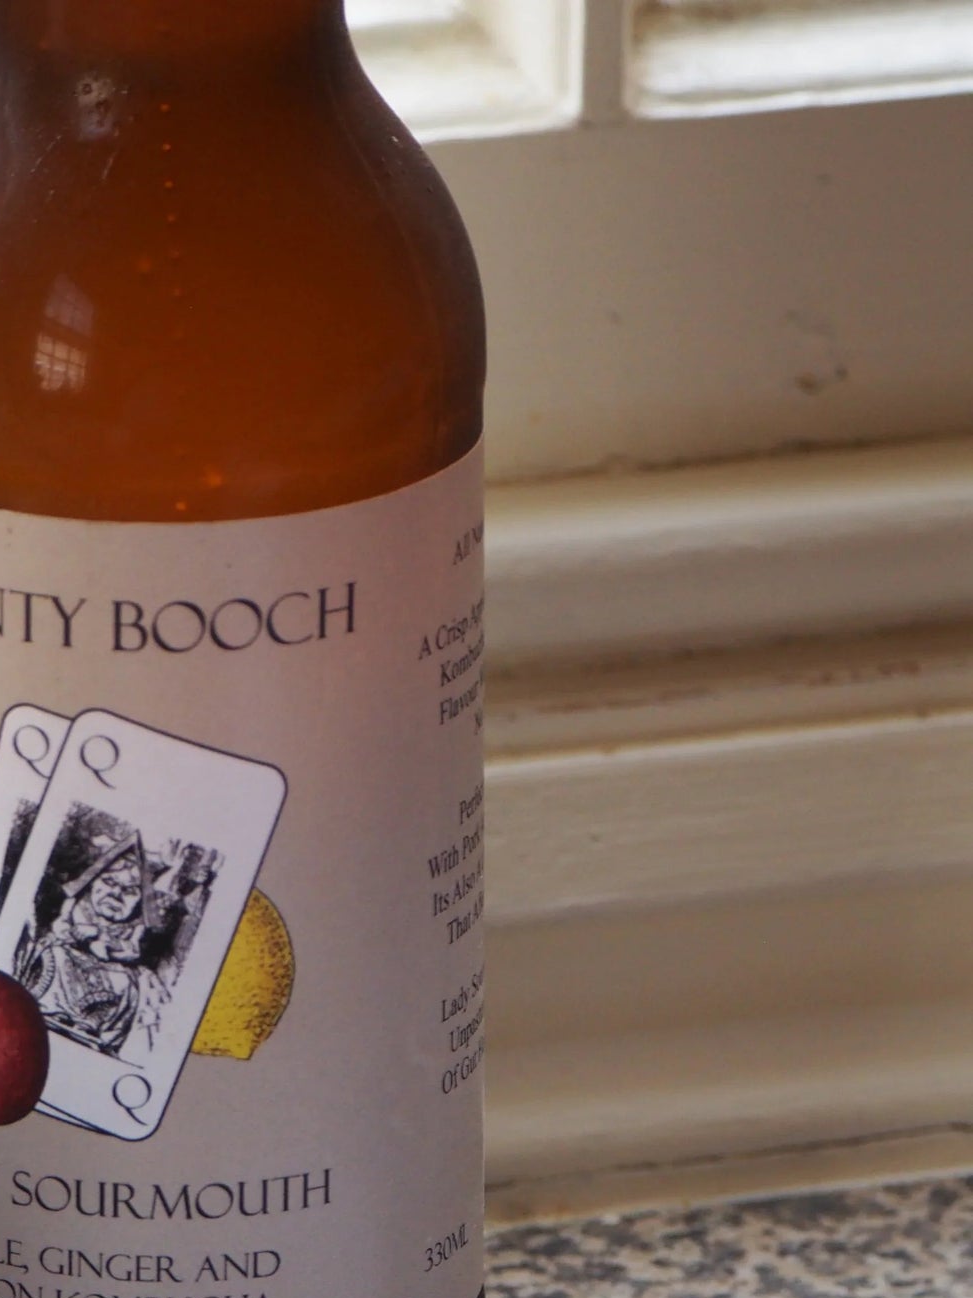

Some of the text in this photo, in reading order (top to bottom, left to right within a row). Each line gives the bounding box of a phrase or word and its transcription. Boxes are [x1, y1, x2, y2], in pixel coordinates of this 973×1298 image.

[452, 530, 471, 565] All
[110, 581, 358, 653] BOOCH
[418, 616, 469, 660] A Crisp
[440, 630, 484, 688] Kombu
[12, 724, 50, 780] Q
[80, 734, 119, 790] Q
[428, 843, 459, 880] With
[433, 891, 450, 918] Its
[452, 870, 477, 905] Also
[447, 910, 471, 946] That
[441, 985, 470, 1023] Lady
[112, 1073, 152, 1126] Q
[442, 1063, 460, 1094] Of
[10, 1167, 333, 1221] SOURMOUTH
[39, 1245, 182, 1284] GINGER
[194, 1249, 282, 1284] AND
[424, 1222, 469, 1274] 330ML
